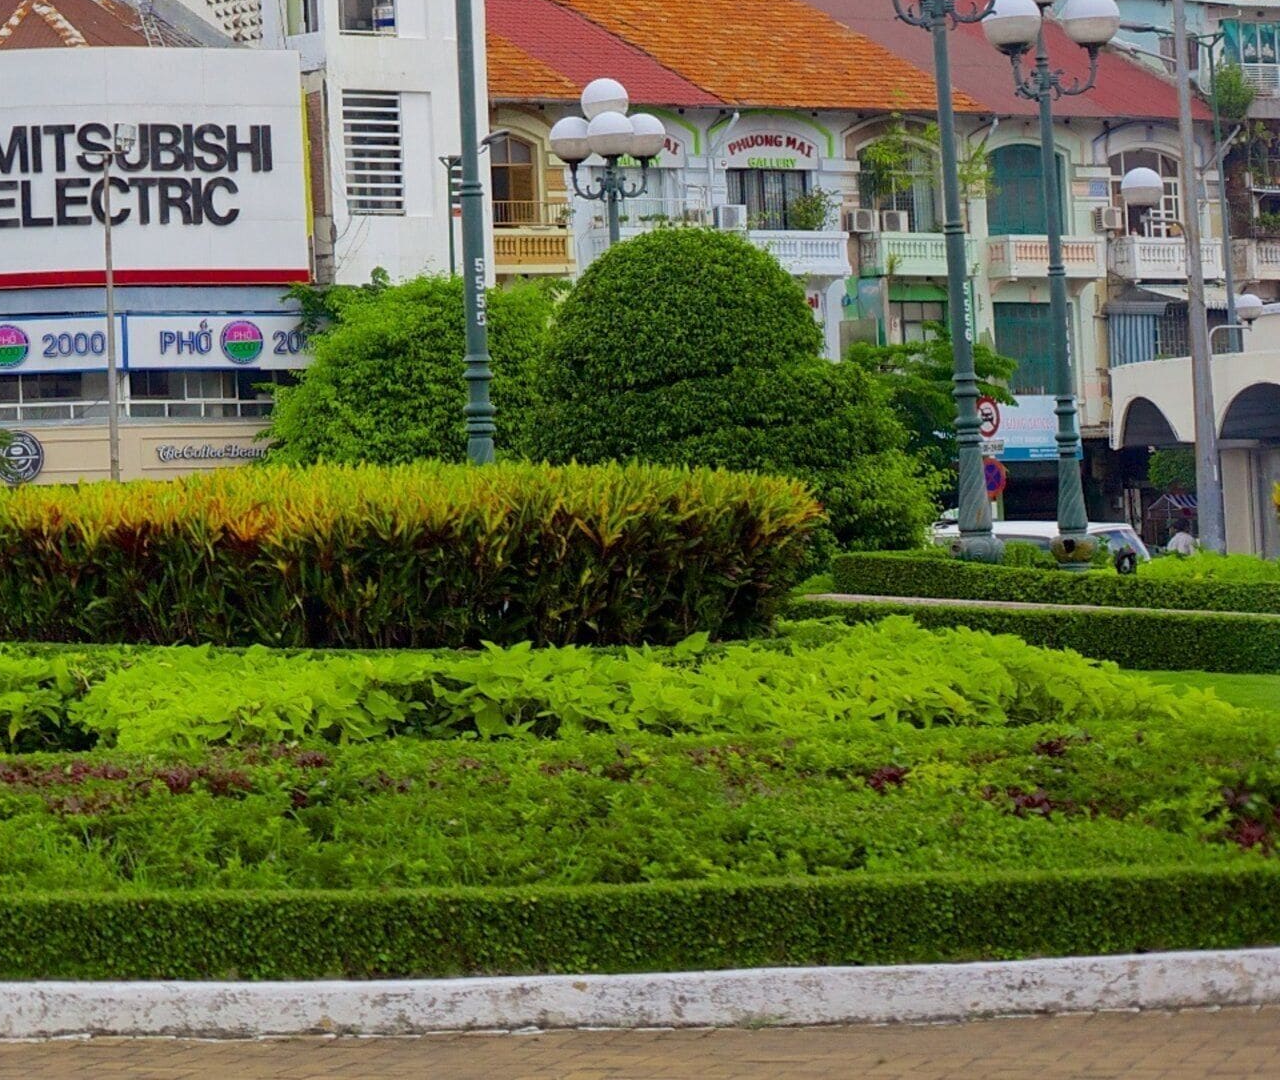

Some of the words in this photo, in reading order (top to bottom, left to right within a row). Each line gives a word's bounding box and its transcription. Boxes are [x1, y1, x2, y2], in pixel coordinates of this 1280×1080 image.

[786, 135, 814, 158] MAI
[748, 157, 797, 168] GALLERY
[42, 331, 106, 358] 2000
[182, 444, 225, 460] Coffee
